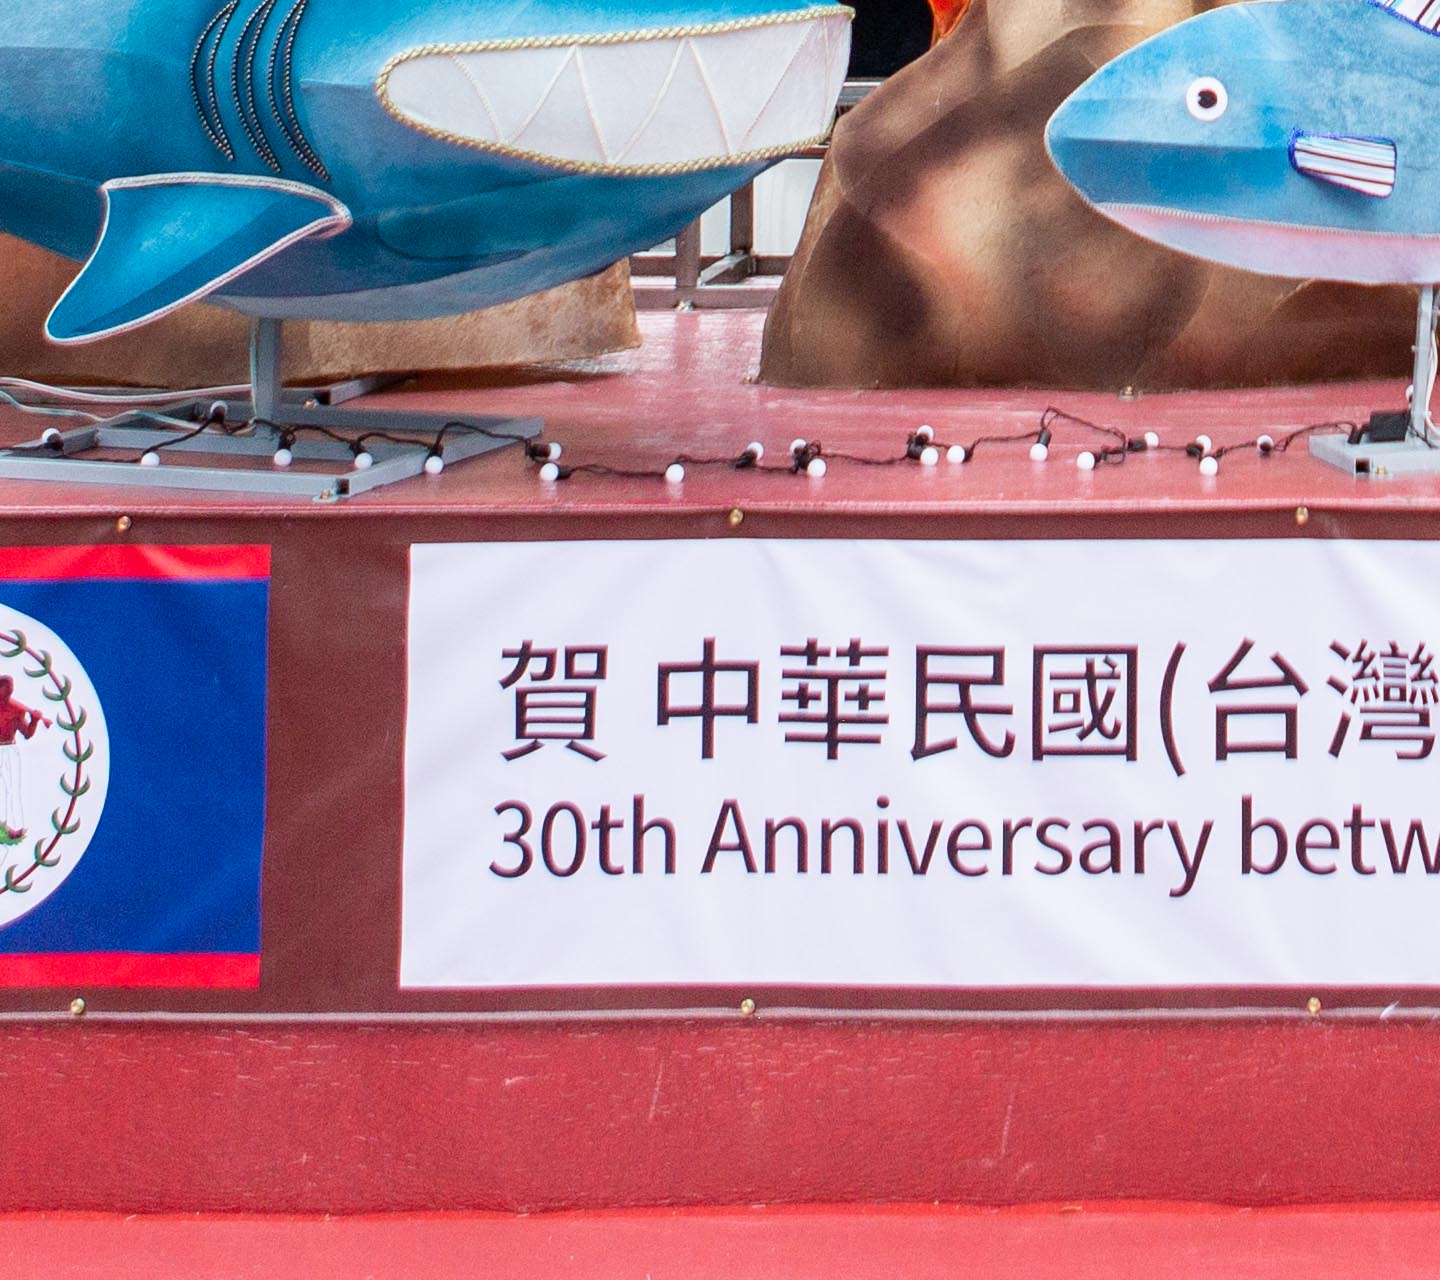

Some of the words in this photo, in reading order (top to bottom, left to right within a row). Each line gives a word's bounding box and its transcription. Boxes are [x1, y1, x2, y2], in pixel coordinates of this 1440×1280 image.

[498, 639, 608, 762] 賀
[487, 794, 676, 879] 30th
[699, 794, 1214, 898] Anniversary
